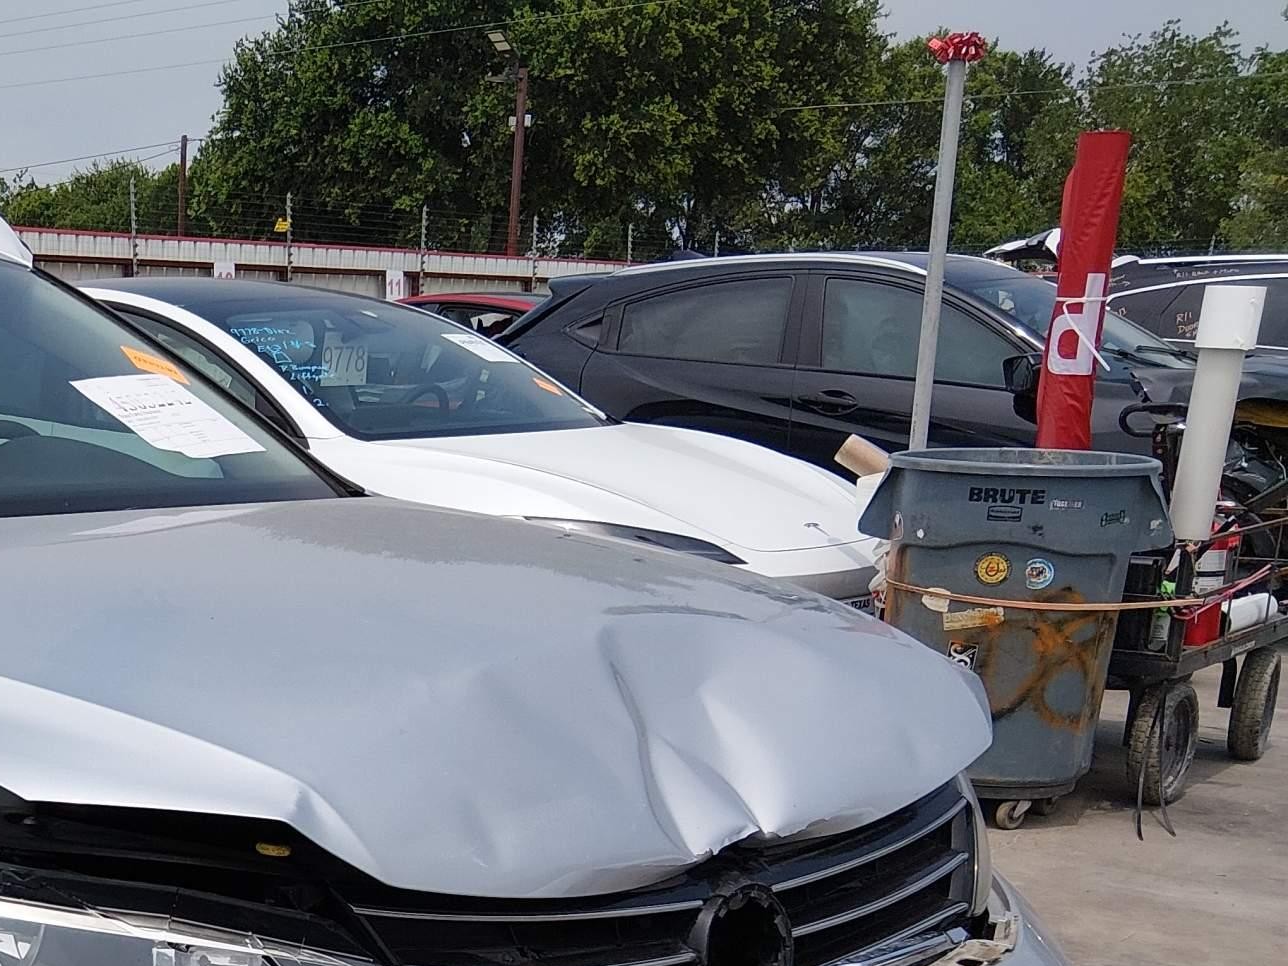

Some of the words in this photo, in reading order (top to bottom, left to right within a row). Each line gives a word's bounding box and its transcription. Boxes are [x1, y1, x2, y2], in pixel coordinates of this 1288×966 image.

[387, 278, 401, 296] 11
[323, 345, 365, 373] 9778
[968, 486, 1046, 505] BRUTE
